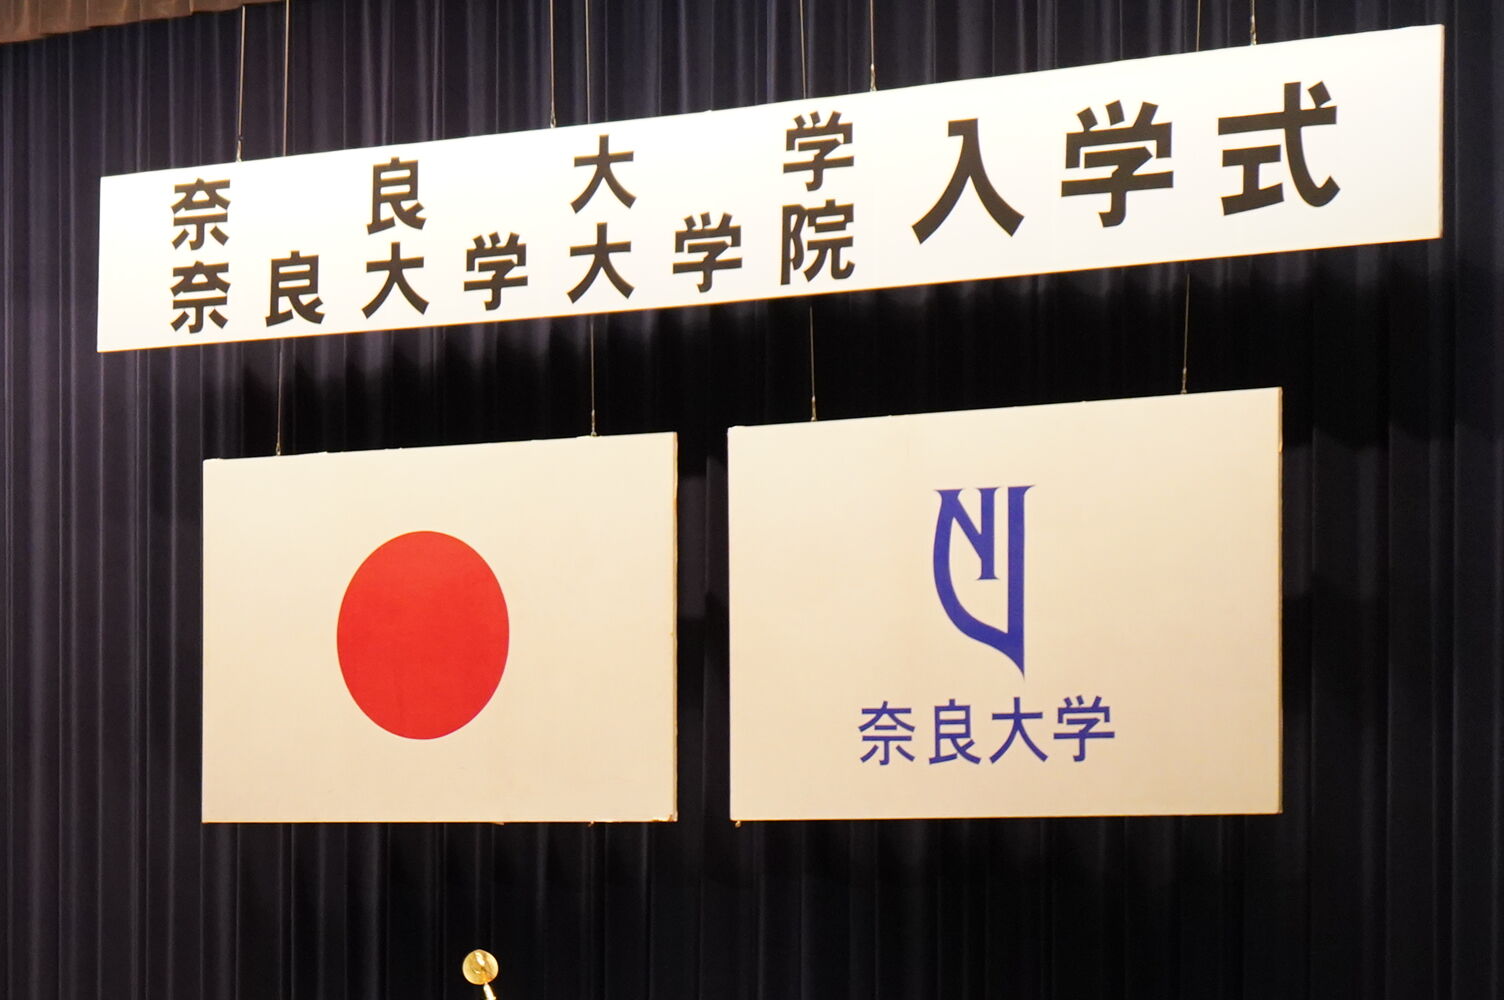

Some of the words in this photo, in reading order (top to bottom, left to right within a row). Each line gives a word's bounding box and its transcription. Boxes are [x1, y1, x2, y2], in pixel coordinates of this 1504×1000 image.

[171, 111, 855, 251] 奈良大学
[911, 81, 1341, 245] 入学式
[170, 199, 855, 332] 奈良大学大学院
[858, 695, 1116, 766] 奈良大学
